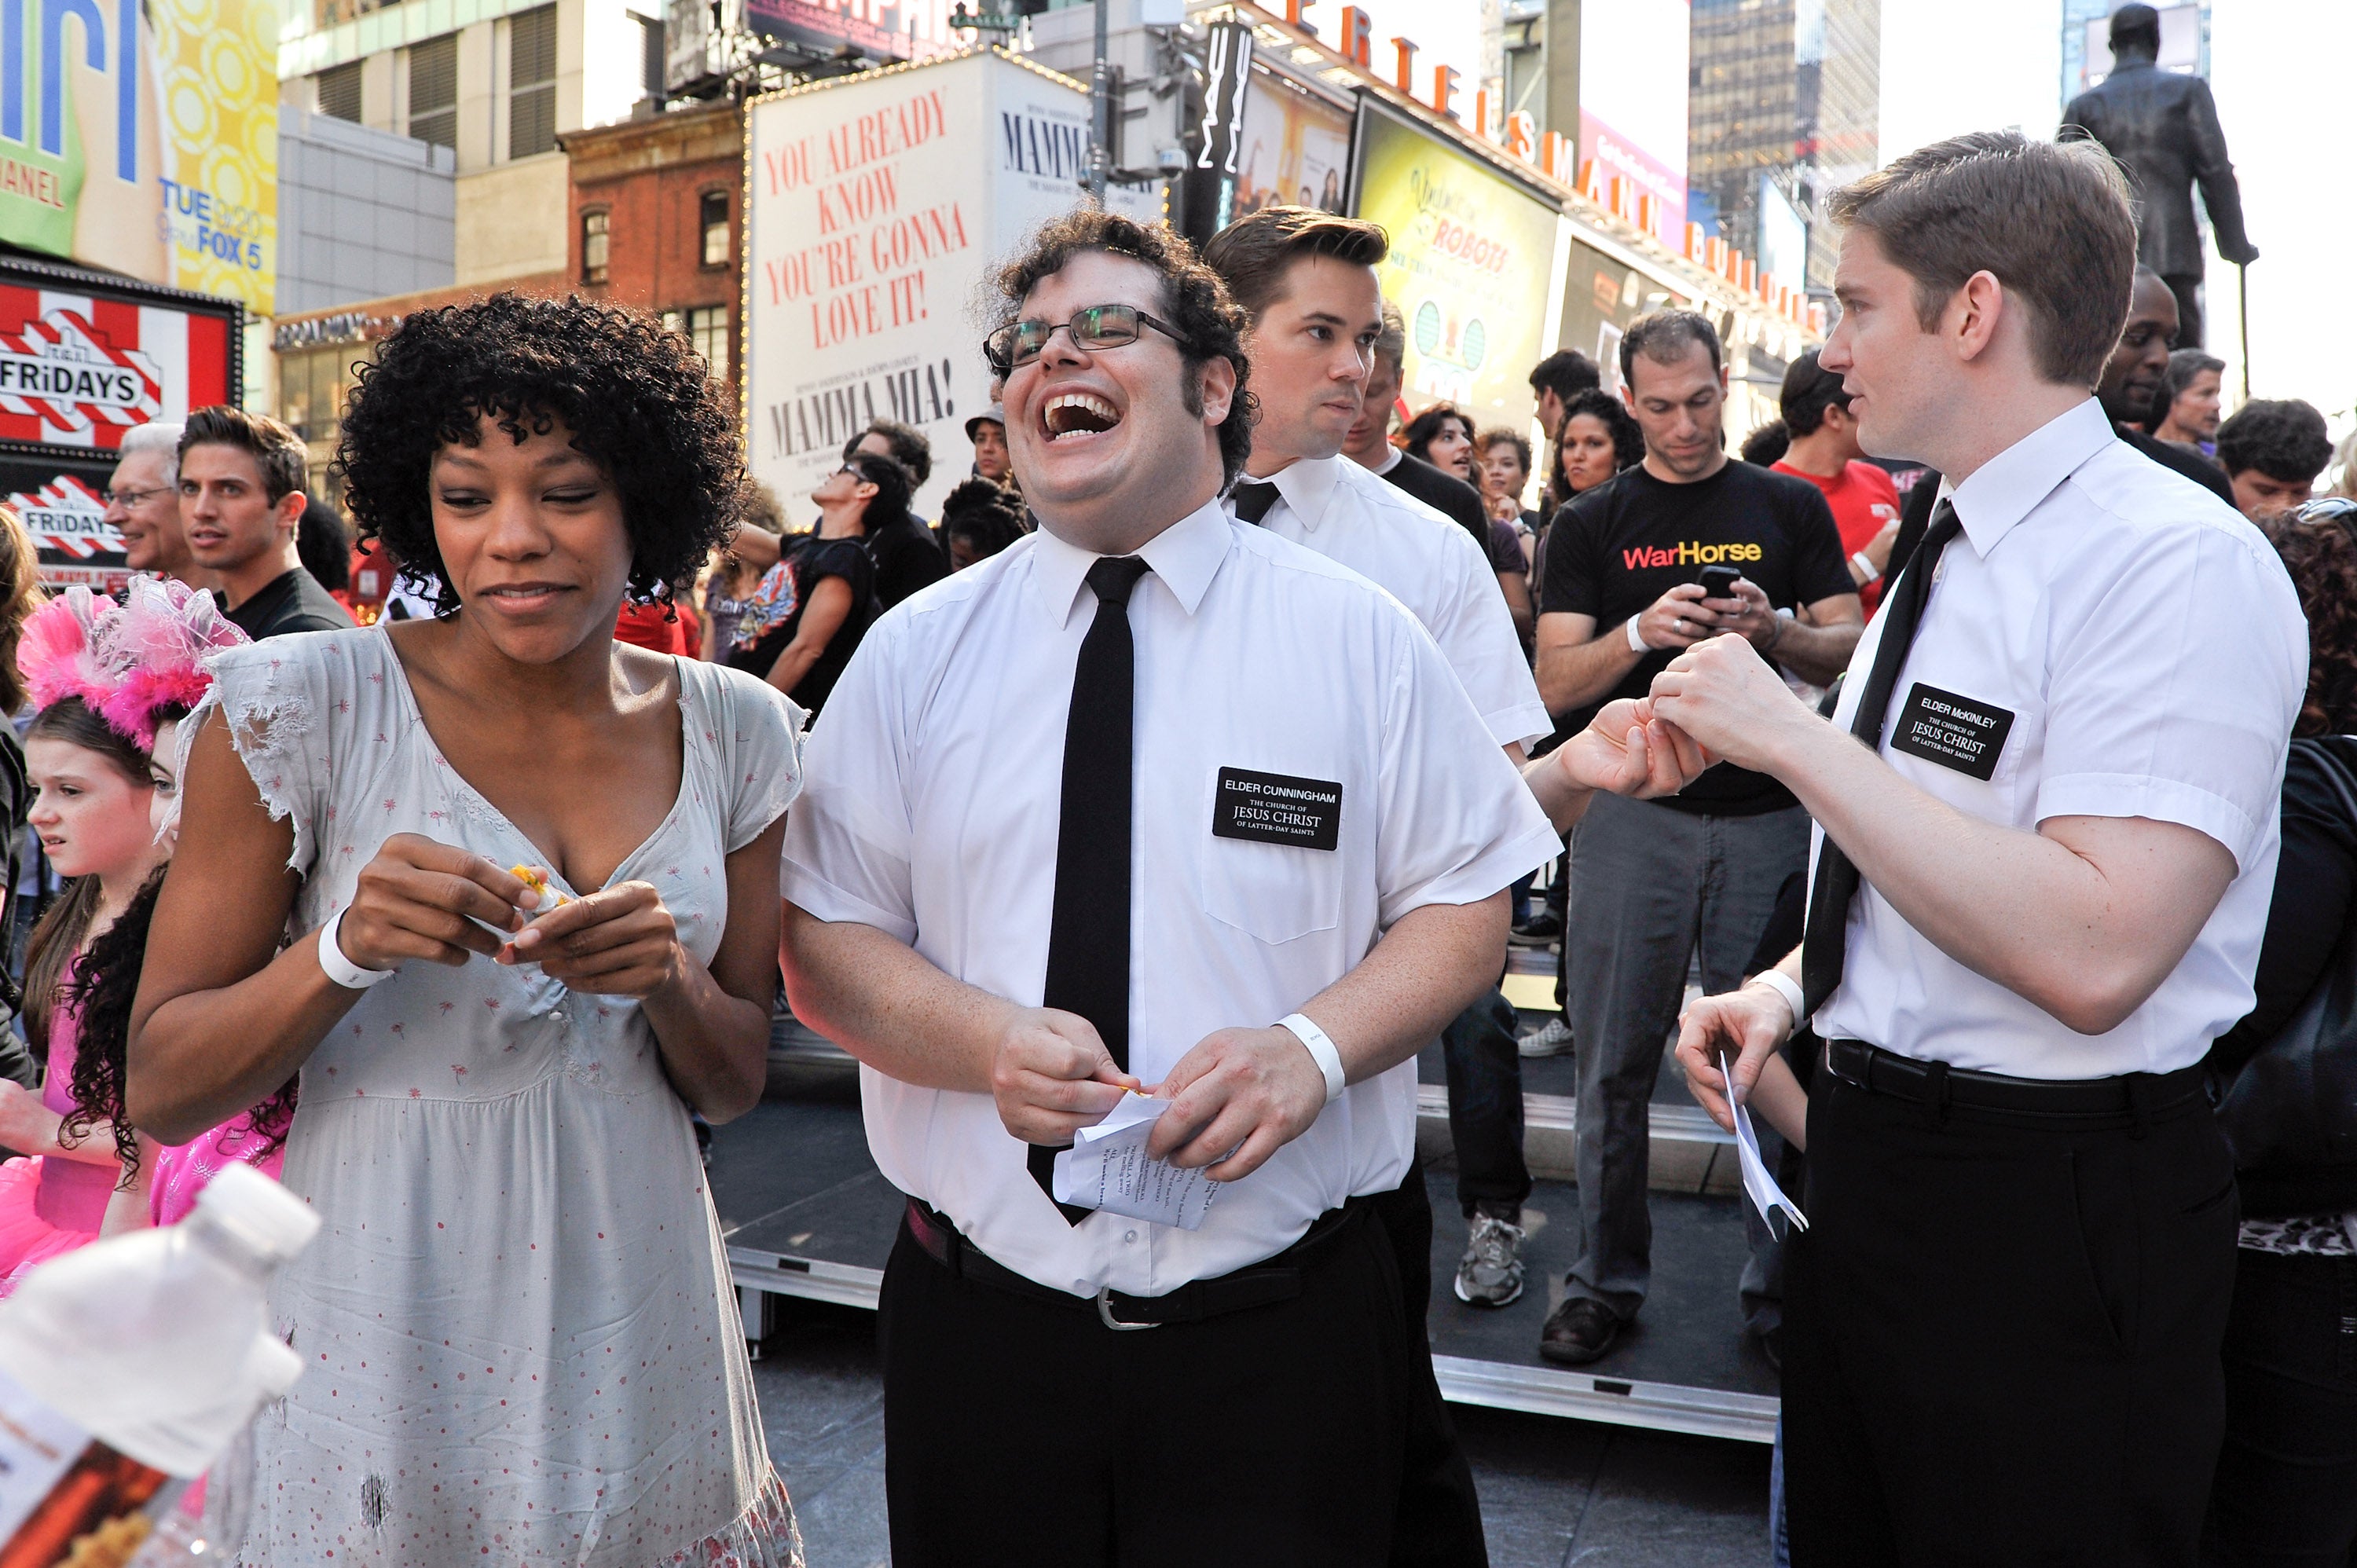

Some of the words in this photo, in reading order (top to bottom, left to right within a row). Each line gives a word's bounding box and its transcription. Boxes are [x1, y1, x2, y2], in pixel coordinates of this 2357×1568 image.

[764, 134, 816, 196] YOU
[825, 84, 948, 178] ALREADY
[1002, 112, 1093, 178] MAMM
[0, 157, 65, 211] ANEL
[157, 176, 211, 222] TUE
[818, 159, 901, 236] KNOW
[198, 225, 243, 267] FOX
[247, 242, 262, 270] 5
[765, 234, 863, 306] YOU'RE
[871, 200, 970, 275] GONNA
[1432, 218, 1509, 273] ROBOTS
[811, 284, 882, 349] LOVE
[889, 269, 928, 327] IT!
[769, 381, 875, 460] MAMMA
[886, 358, 954, 425] MIA!
[1622, 540, 1762, 570] WarHorse
[1921, 697, 1952, 715] ELDER
[1951, 707, 1997, 730] McKINLEY
[1929, 716, 1941, 726] THE
[1941, 720, 1967, 735] CHURCH
[1968, 729, 1978, 738] OF
[1910, 721, 1943, 741] JESUS
[1943, 732, 1986, 756] CHRIST
[1921, 738, 1955, 755] LATTER-DAY
[1954, 749, 1976, 763] SAINTS
[1225, 779, 1261, 793] ELDER
[1263, 785, 1336, 804] CUNNINGHAM
[1265, 801, 1296, 811] CHURCH
[1232, 805, 1270, 821] JESUS
[1272, 811, 1322, 828] CHRIST
[1248, 822, 1289, 833] LATTER-DAY
[1290, 828, 1315, 837] SAINTS
